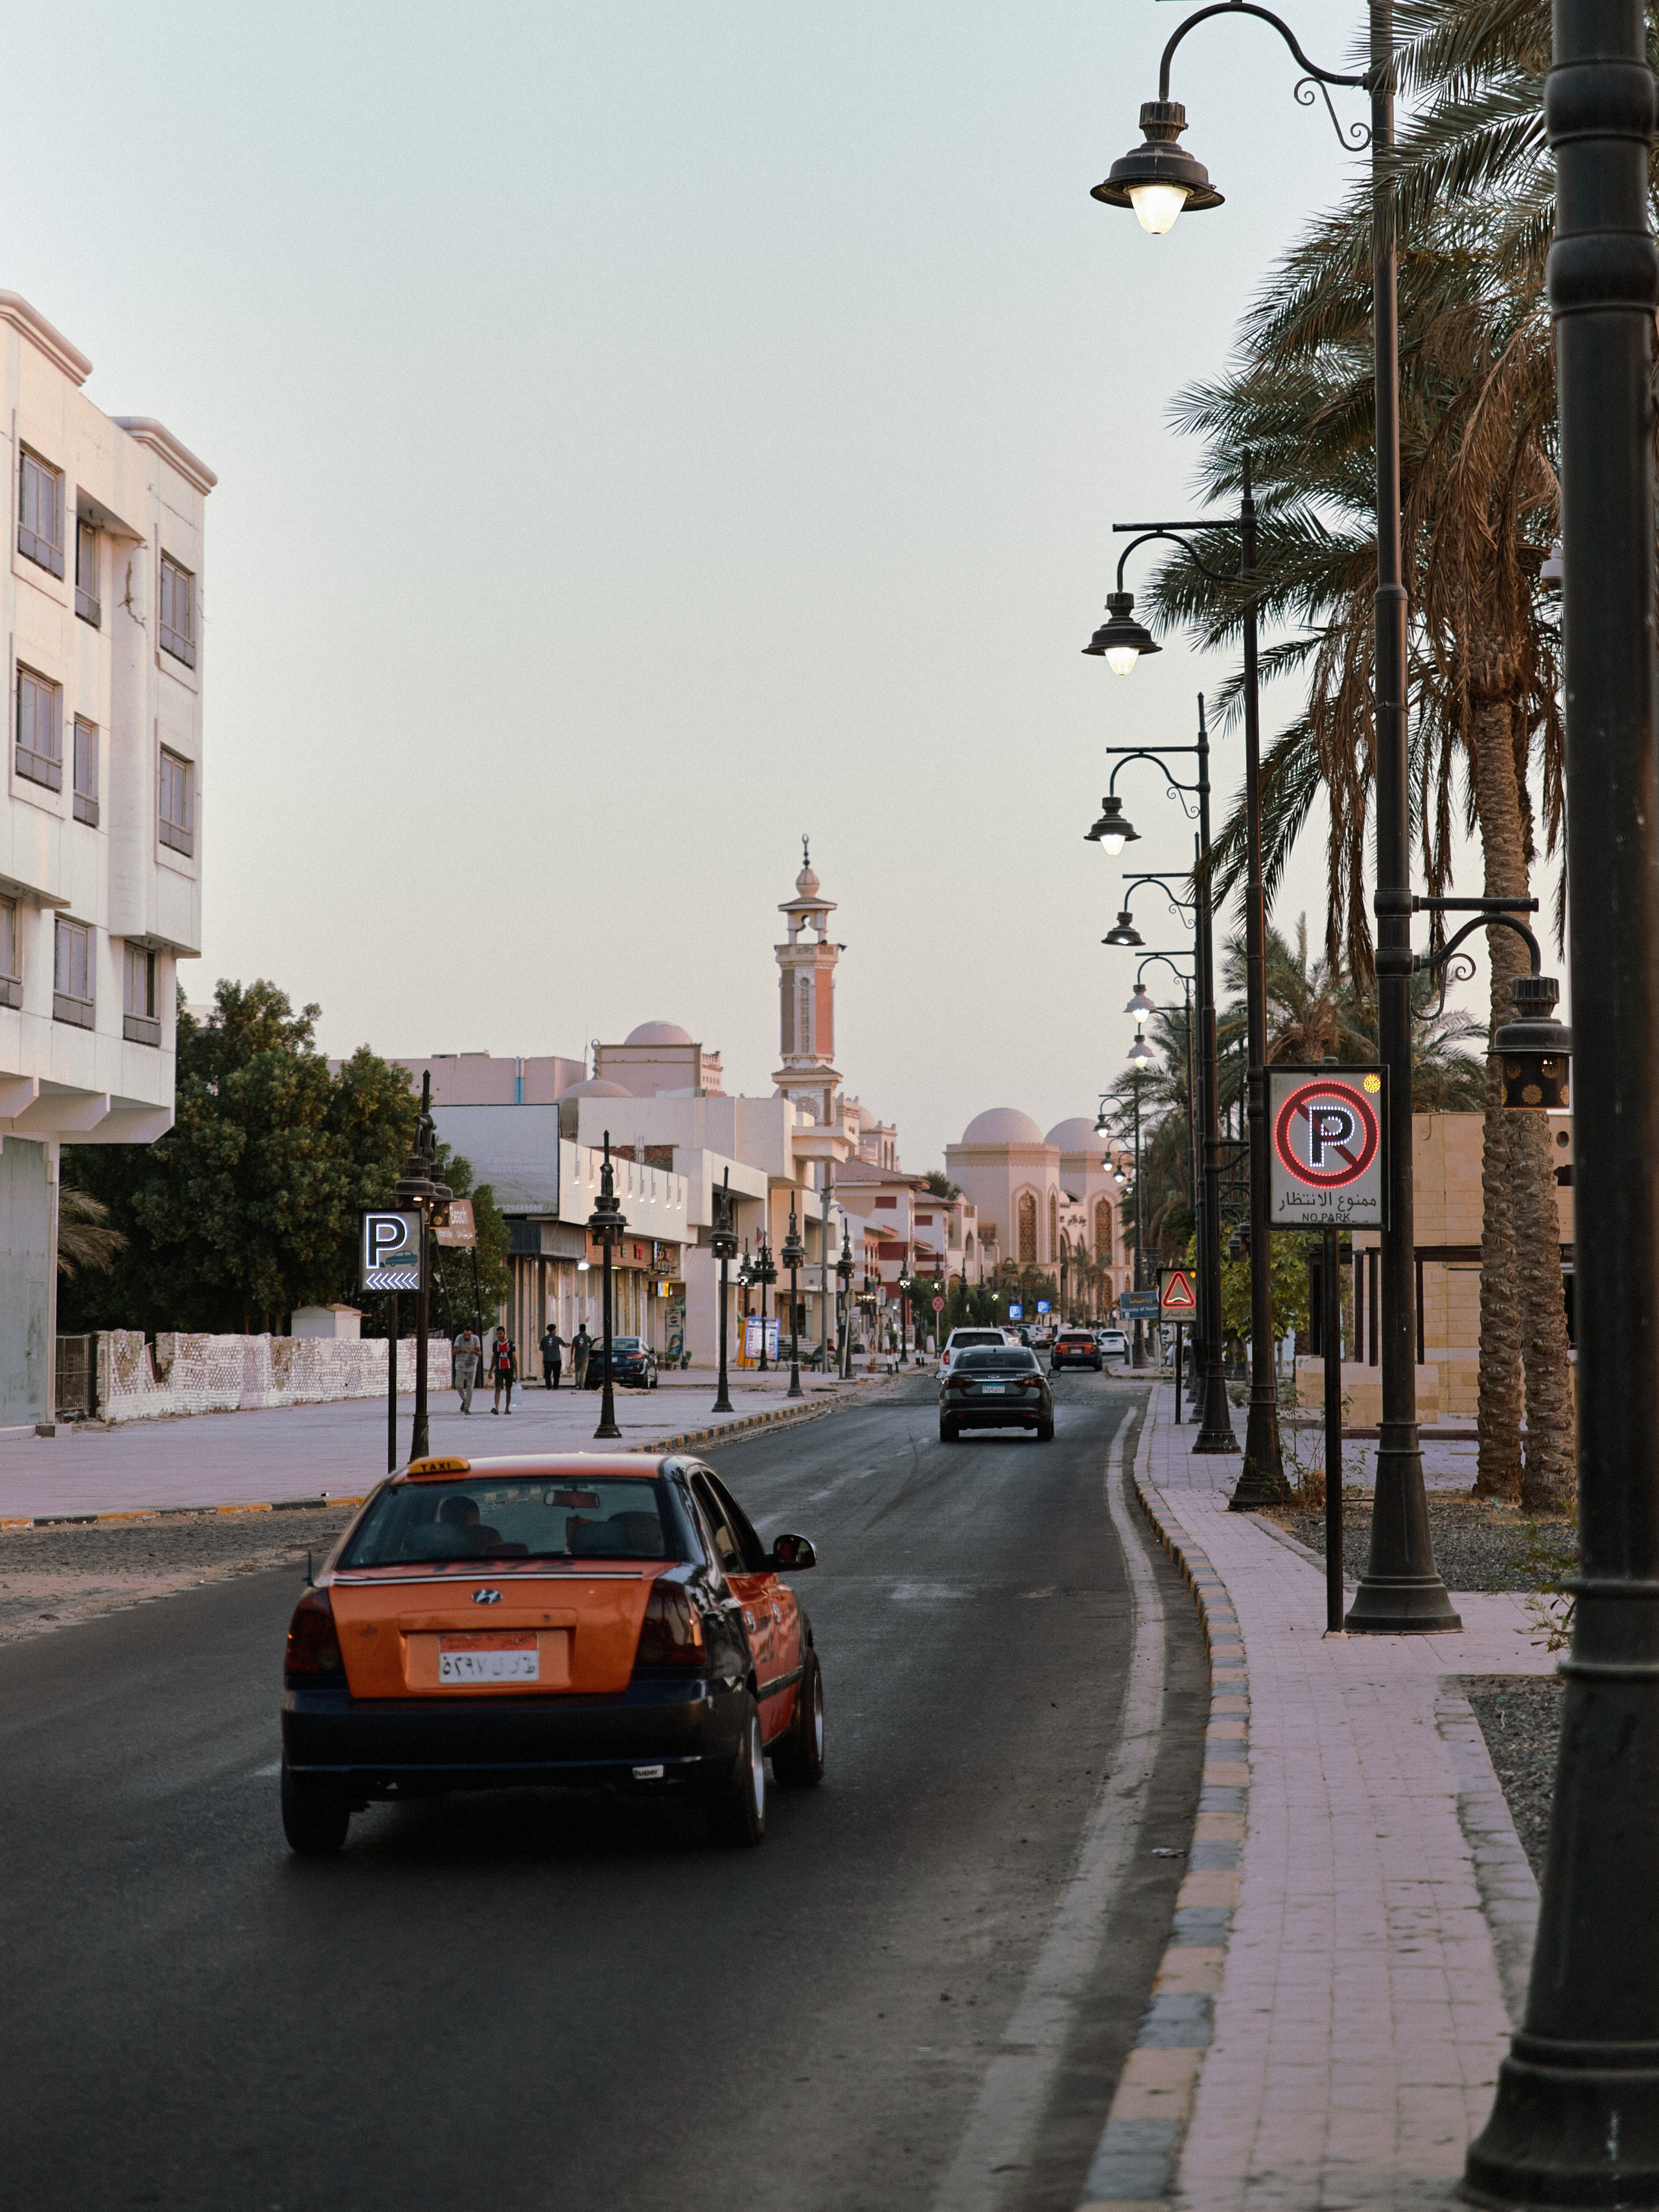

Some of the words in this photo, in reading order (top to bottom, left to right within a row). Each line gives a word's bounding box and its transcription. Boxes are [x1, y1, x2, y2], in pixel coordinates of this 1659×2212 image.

[1309, 1106, 1354, 1167] P
[1278, 1191, 1332, 1211] الانتظار
[1337, 1194, 1376, 1212] ممنوع
[1302, 1213, 1317, 1222] NO
[1321, 1213, 1351, 1222] PARK
[365, 1213, 408, 1270] P
[1010, 1306, 1019, 1318] P
[421, 1461, 451, 1472] TAXI
